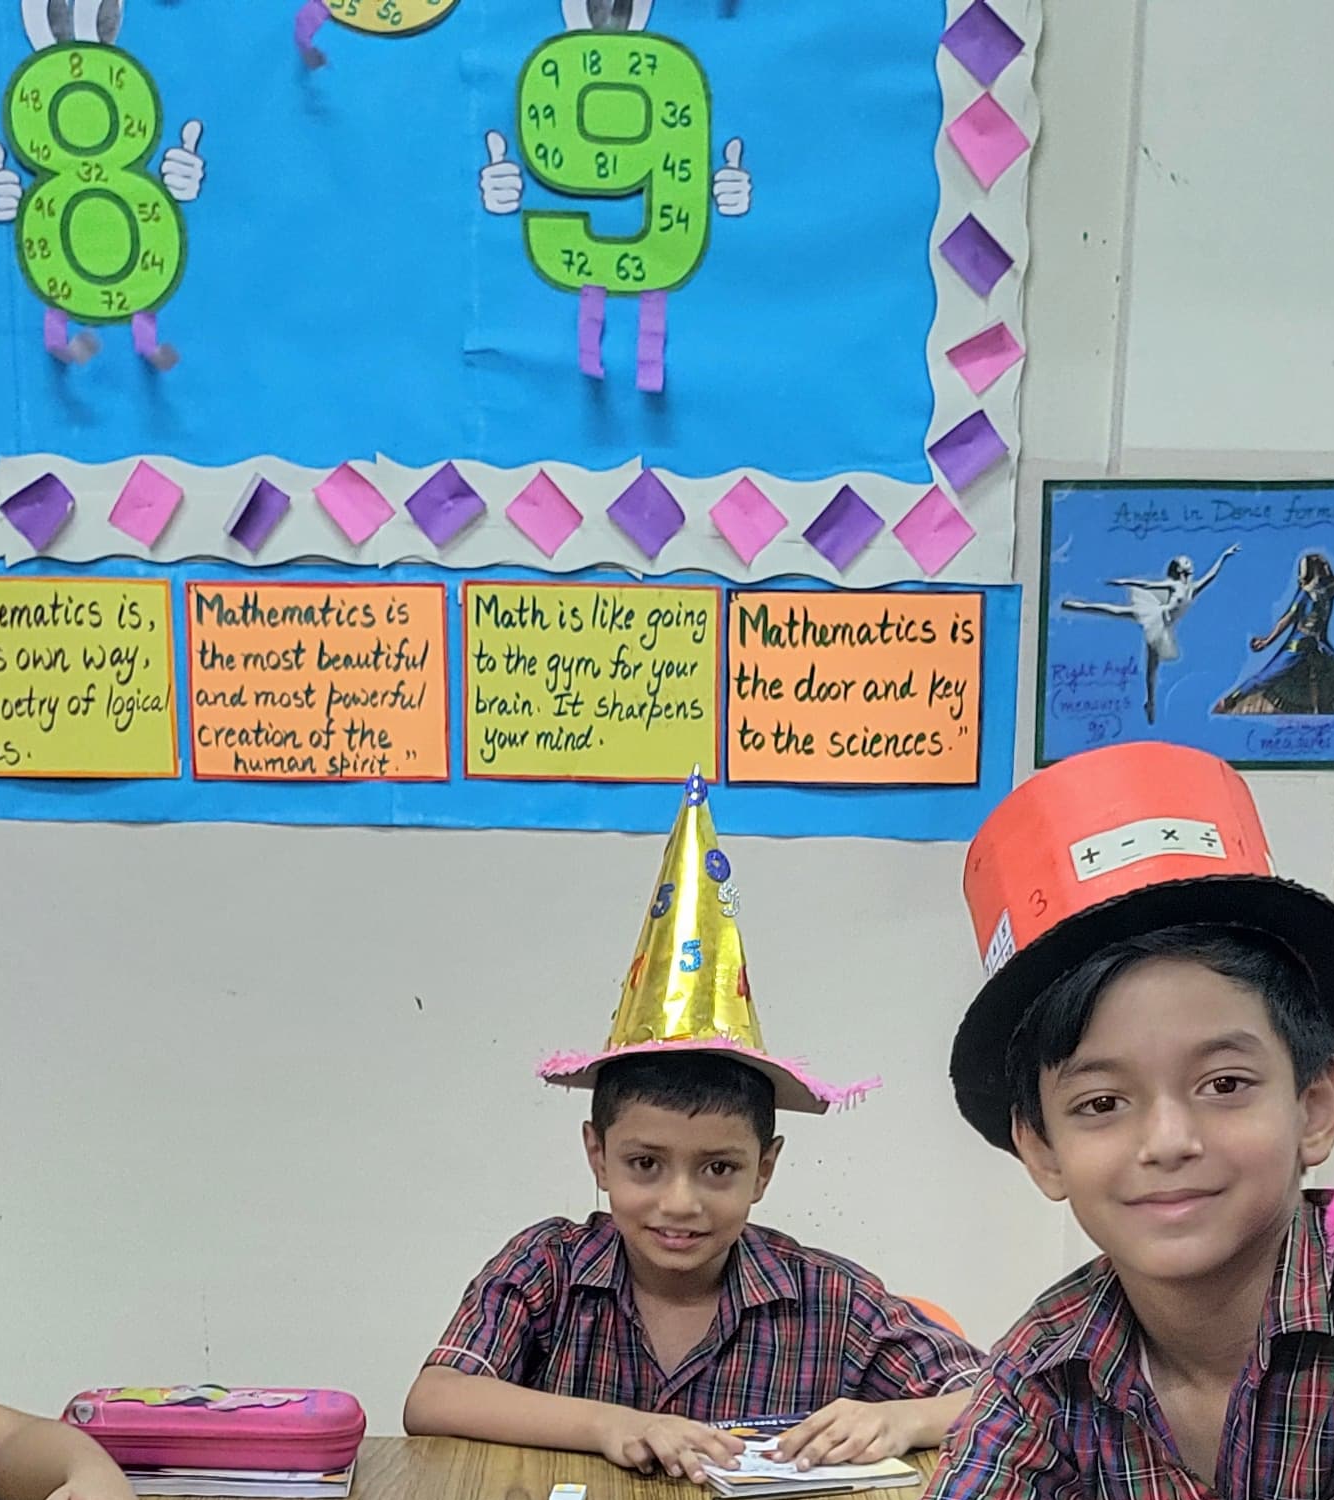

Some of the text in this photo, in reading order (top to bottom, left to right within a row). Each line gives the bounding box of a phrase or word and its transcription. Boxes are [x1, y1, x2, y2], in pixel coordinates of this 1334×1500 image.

[68, 52, 84, 79] 8
[542, 59, 559, 89] 9
[582, 49, 602, 76] 18
[628, 52, 658, 77] 27
[19, 88, 43, 112] 48
[660, 100, 692, 128] 36
[123, 115, 147, 139] 24
[527, 103, 556, 130] 99
[28, 138, 52, 162] 40
[535, 142, 564, 171] 90
[594, 151, 617, 179] 81
[77, 161, 109, 182] 32
[663, 152, 691, 182] 45
[659, 204, 690, 234] 54
[141, 250, 165, 275] 64
[561, 249, 593, 277] 72
[616, 252, 646, 282] 63
[101, 291, 131, 312] 72
[116, 593, 157, 634] is,
[386, 592, 411, 625] is
[474, 591, 709, 650] Math is like going
[950, 609, 976, 648] is
[15, 644, 72, 674] own
[198, 636, 431, 674] the most beautiful
[471, 640, 699, 694] to the gym for your
[196, 677, 427, 718] and most powerful
[732, 660, 967, 721] the door and key
[66, 684, 99, 717] of
[104, 684, 172, 733] logical
[474, 690, 706, 732] brain. It sharpens
[197, 716, 393, 755] creation of the
[480, 724, 606, 764] your mind.
[736, 719, 768, 754] to
[772, 719, 816, 754] the
[233, 750, 318, 775] human
[679, 938, 703, 973] 5
